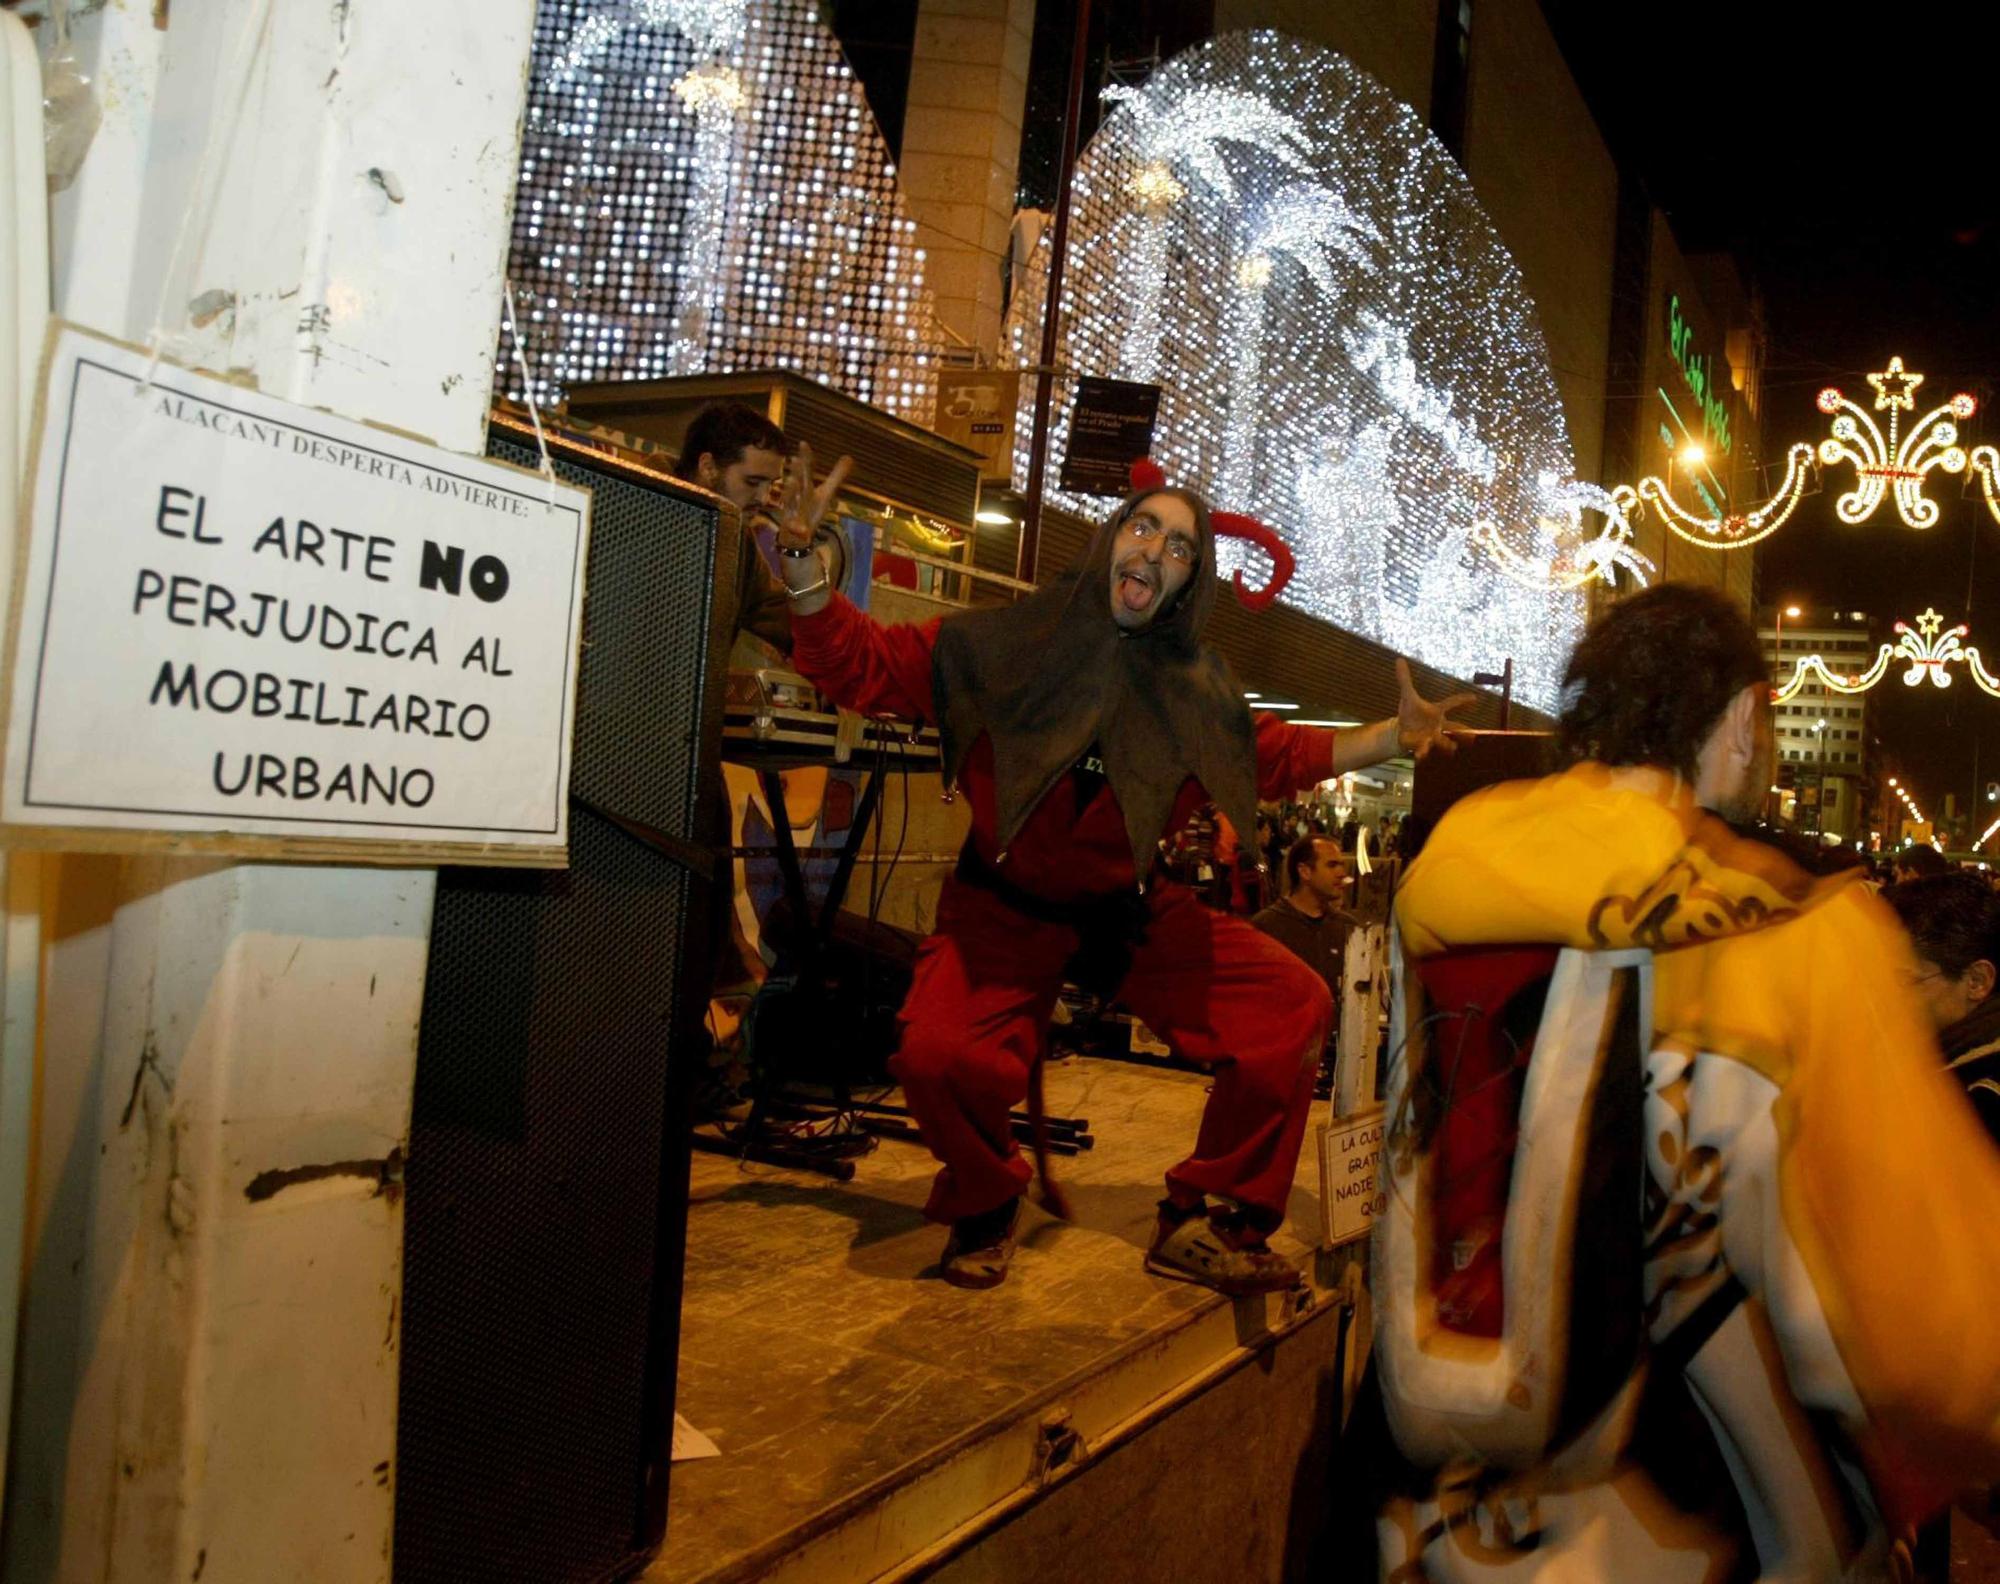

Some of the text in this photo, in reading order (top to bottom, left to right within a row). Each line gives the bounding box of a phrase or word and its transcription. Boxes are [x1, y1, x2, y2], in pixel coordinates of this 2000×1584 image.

[154, 398, 529, 518] ALACANT DESPERTA ADVIERTE:
[156, 485, 510, 603] EL ARTE NO
[133, 569, 513, 677] PERJUDICA AL
[149, 660, 491, 742] MOBILIARIO
[213, 751, 436, 808] URBANO
[1342, 1137, 1355, 1152] LA
[1336, 1178, 1374, 1202] NADIE
